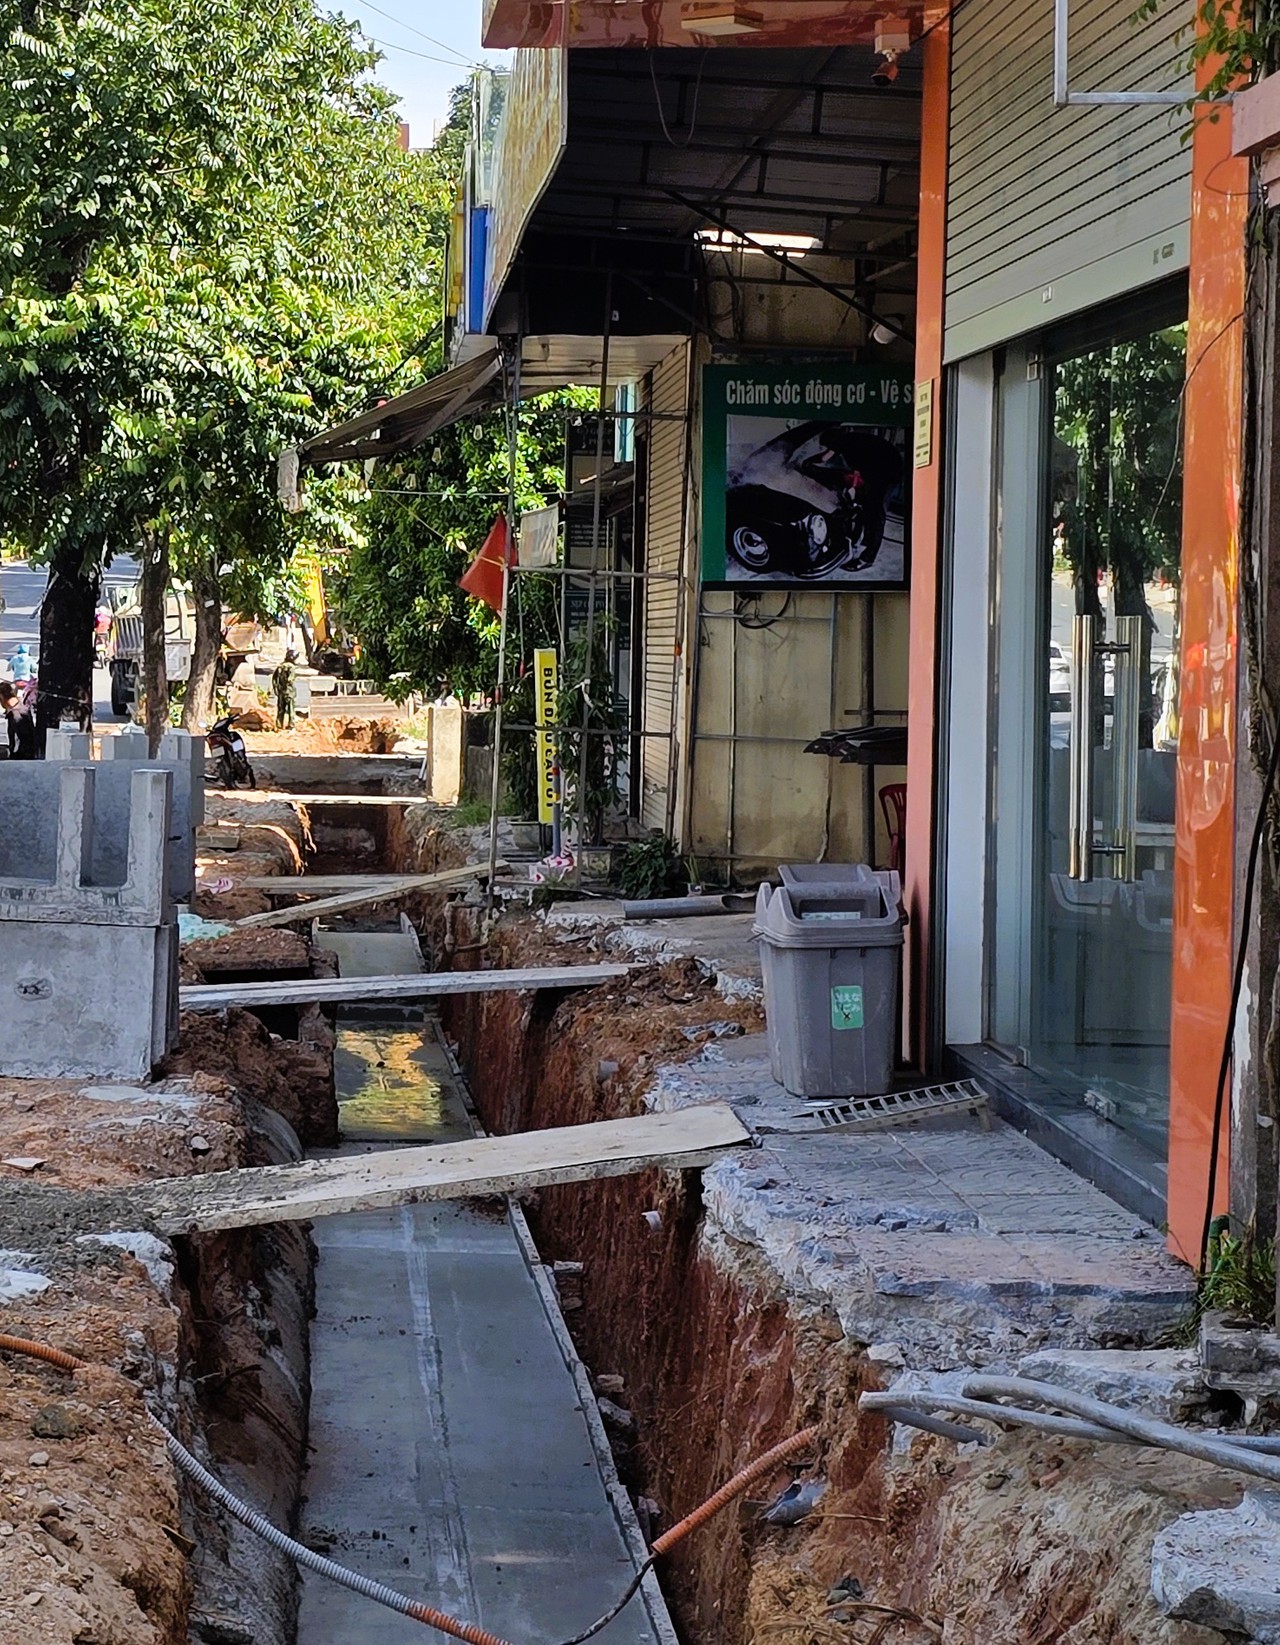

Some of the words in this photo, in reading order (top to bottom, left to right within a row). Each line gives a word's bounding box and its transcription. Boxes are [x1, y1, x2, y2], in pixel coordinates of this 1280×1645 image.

[726, 379, 769, 405] Chăm
[773, 379, 801, 404] sóc
[805, 379, 842, 409] động
[847, 382, 866, 404] cơ
[880, 379, 900, 409] Vệ
[903, 384, 915, 404] s
